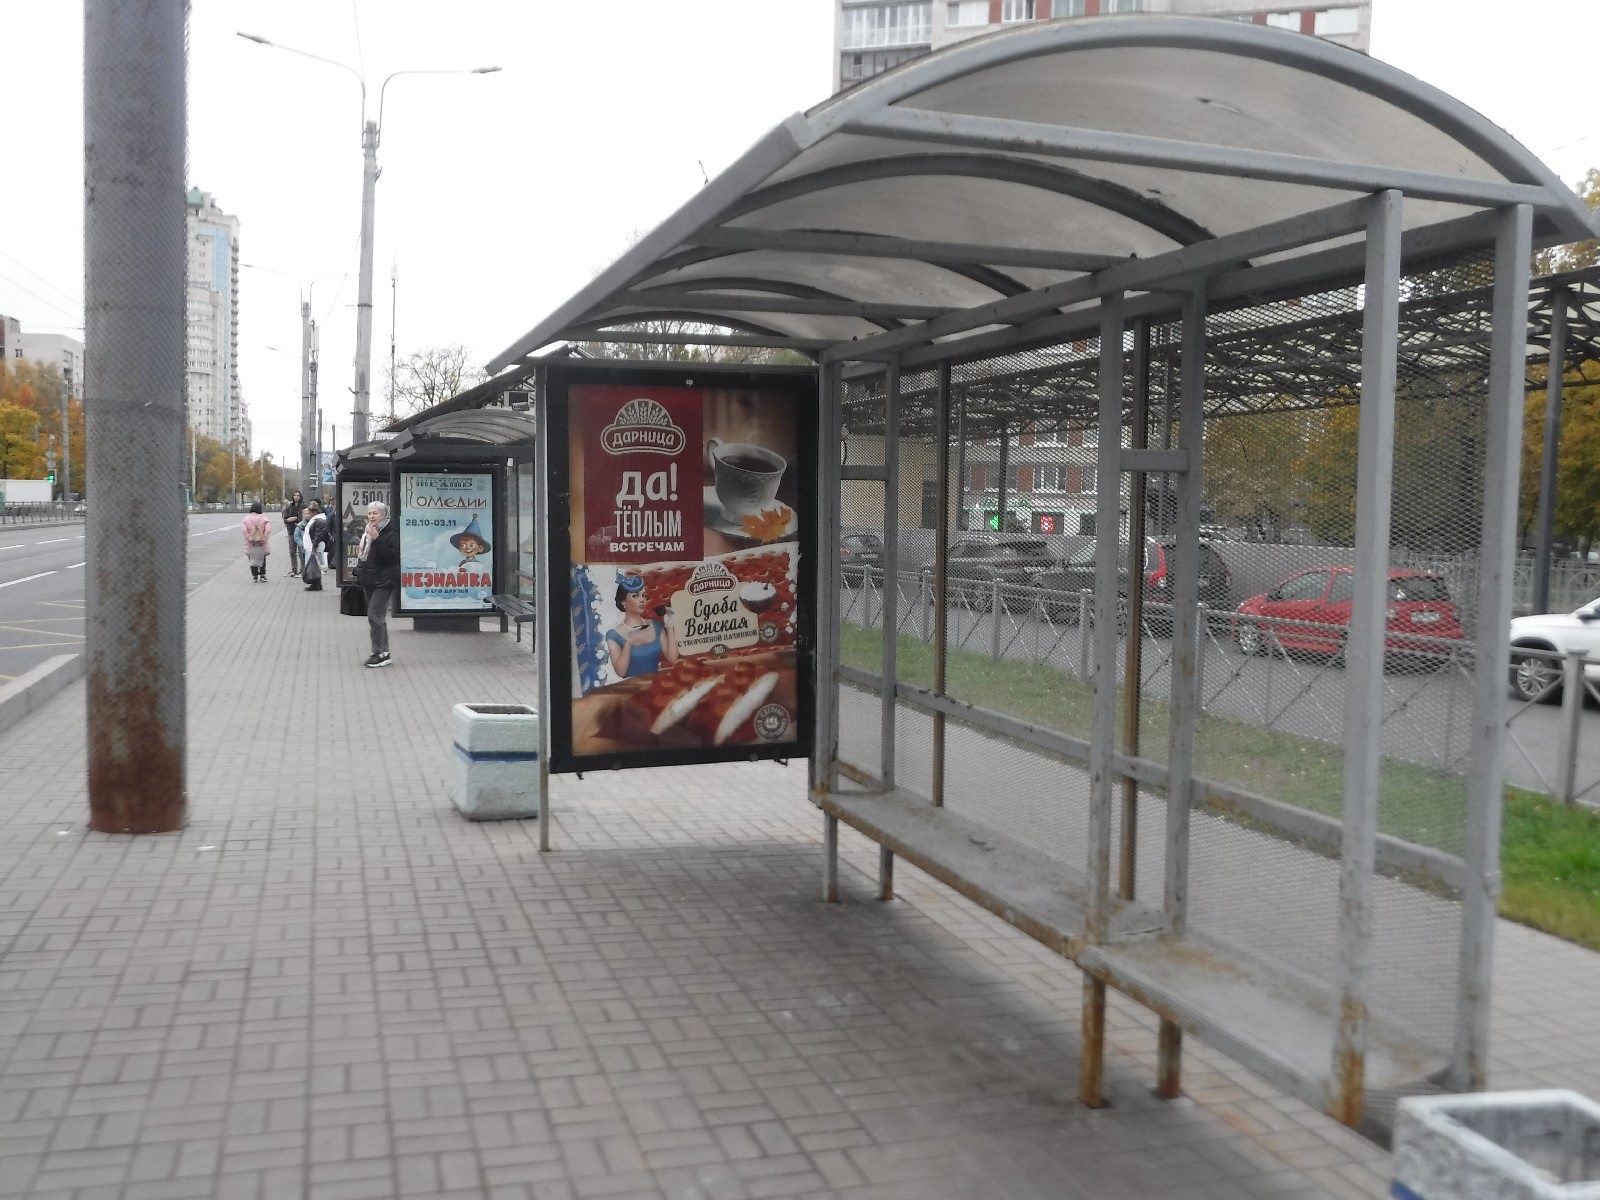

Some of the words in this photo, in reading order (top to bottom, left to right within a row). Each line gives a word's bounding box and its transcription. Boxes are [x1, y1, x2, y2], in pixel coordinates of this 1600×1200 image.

[352, 491, 360, 505] 2
[614, 506, 682, 538] ТЁПЛЫМ
[609, 541, 685, 553] ВСТРЕЧАМ
[401, 571, 491, 587] НЕЗНАЙКА
[693, 596, 738, 621] Сдоба
[684, 616, 748, 638] Венская
[684, 635, 723, 648] ТВОРОЖНОЙ
[723, 629, 758, 642] НАЧИНКОЙ
